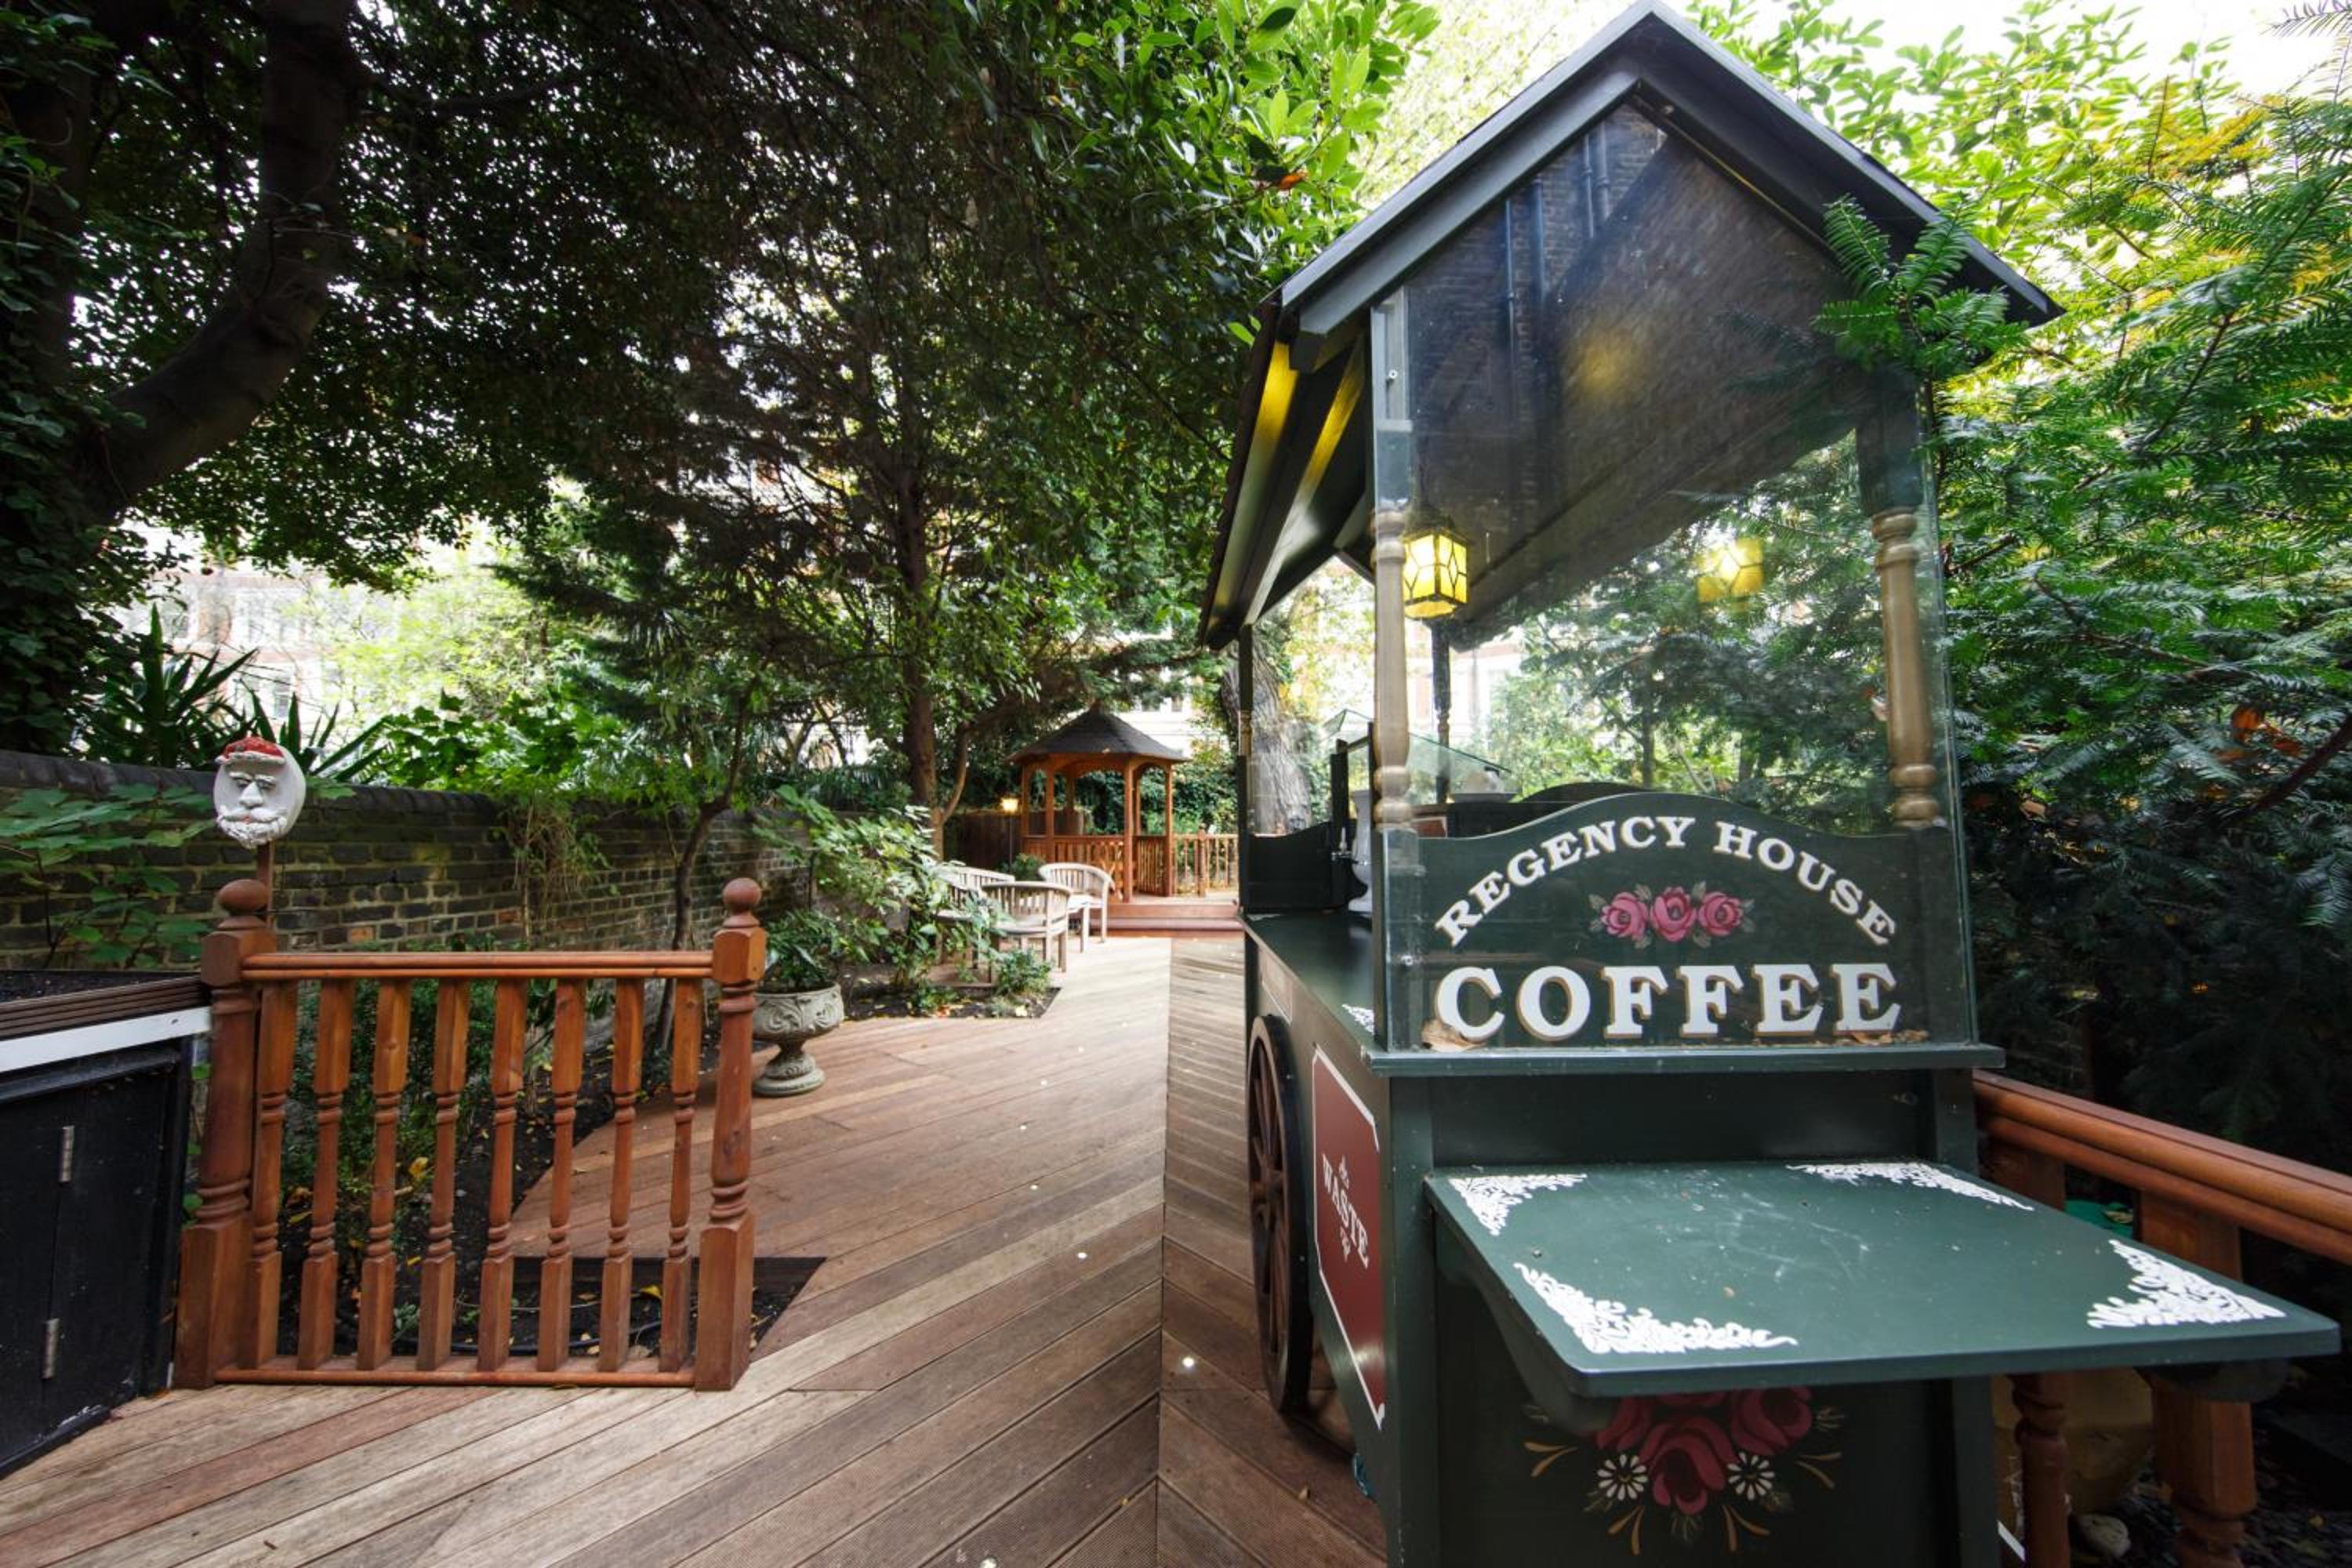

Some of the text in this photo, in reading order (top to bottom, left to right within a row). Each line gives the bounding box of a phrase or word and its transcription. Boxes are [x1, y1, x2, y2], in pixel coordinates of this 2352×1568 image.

[1434, 817, 1896, 946] REGENCY HOUSE
[1434, 964, 1900, 1041] COFFEE
[1322, 1153, 1369, 1269] WASTE
